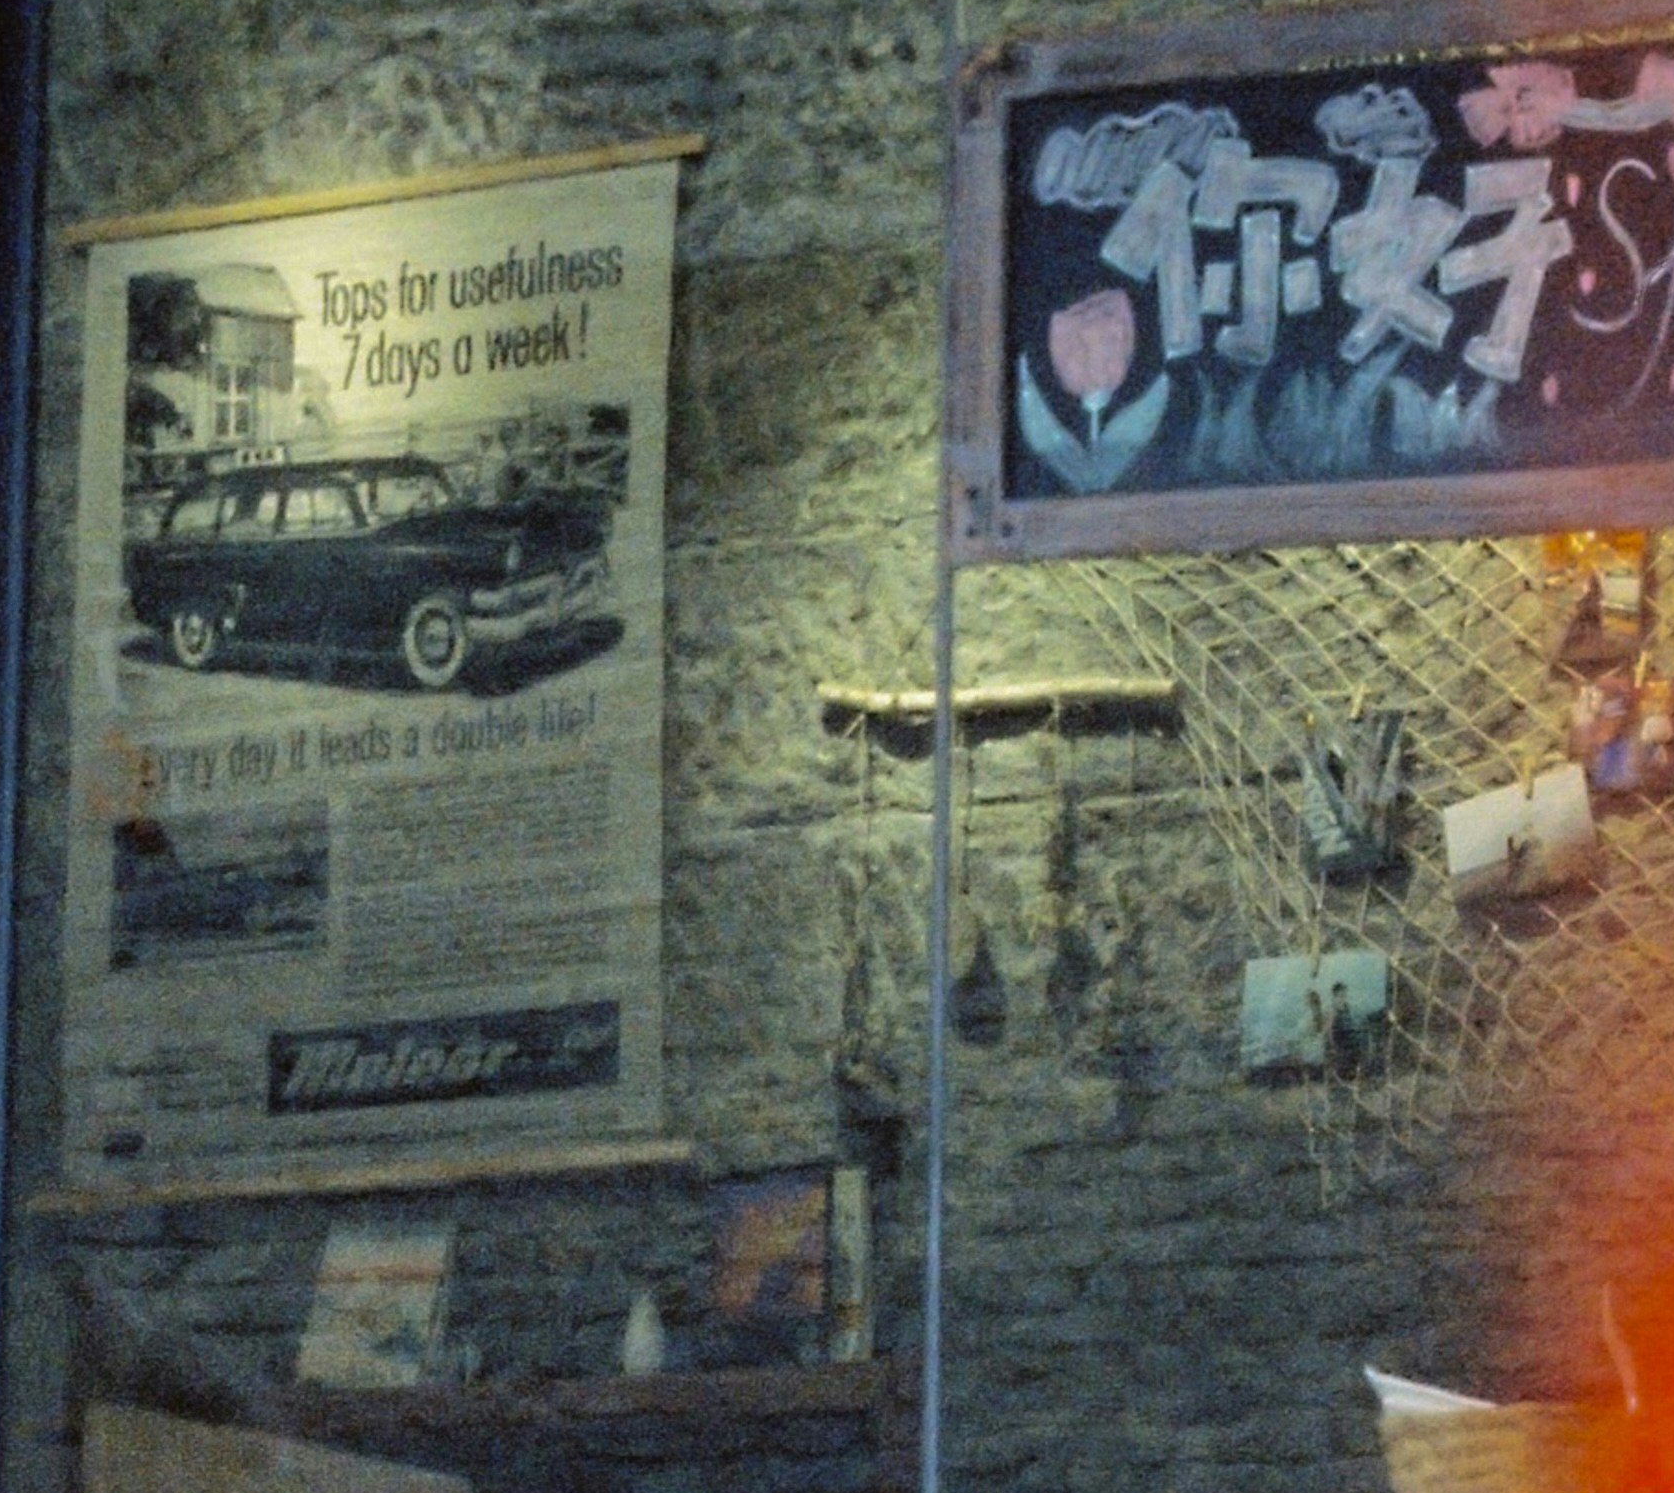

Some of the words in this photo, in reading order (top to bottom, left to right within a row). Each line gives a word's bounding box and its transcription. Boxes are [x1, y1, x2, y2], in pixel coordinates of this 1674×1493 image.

[314, 267, 388, 330] Tops
[398, 259, 439, 318] for
[448, 239, 625, 308] usefulness
[1099, 137, 1574, 383] 你好
[340, 331, 362, 391] 7
[365, 329, 441, 399] days
[453, 333, 473, 376] a
[229, 734, 278, 785] day
